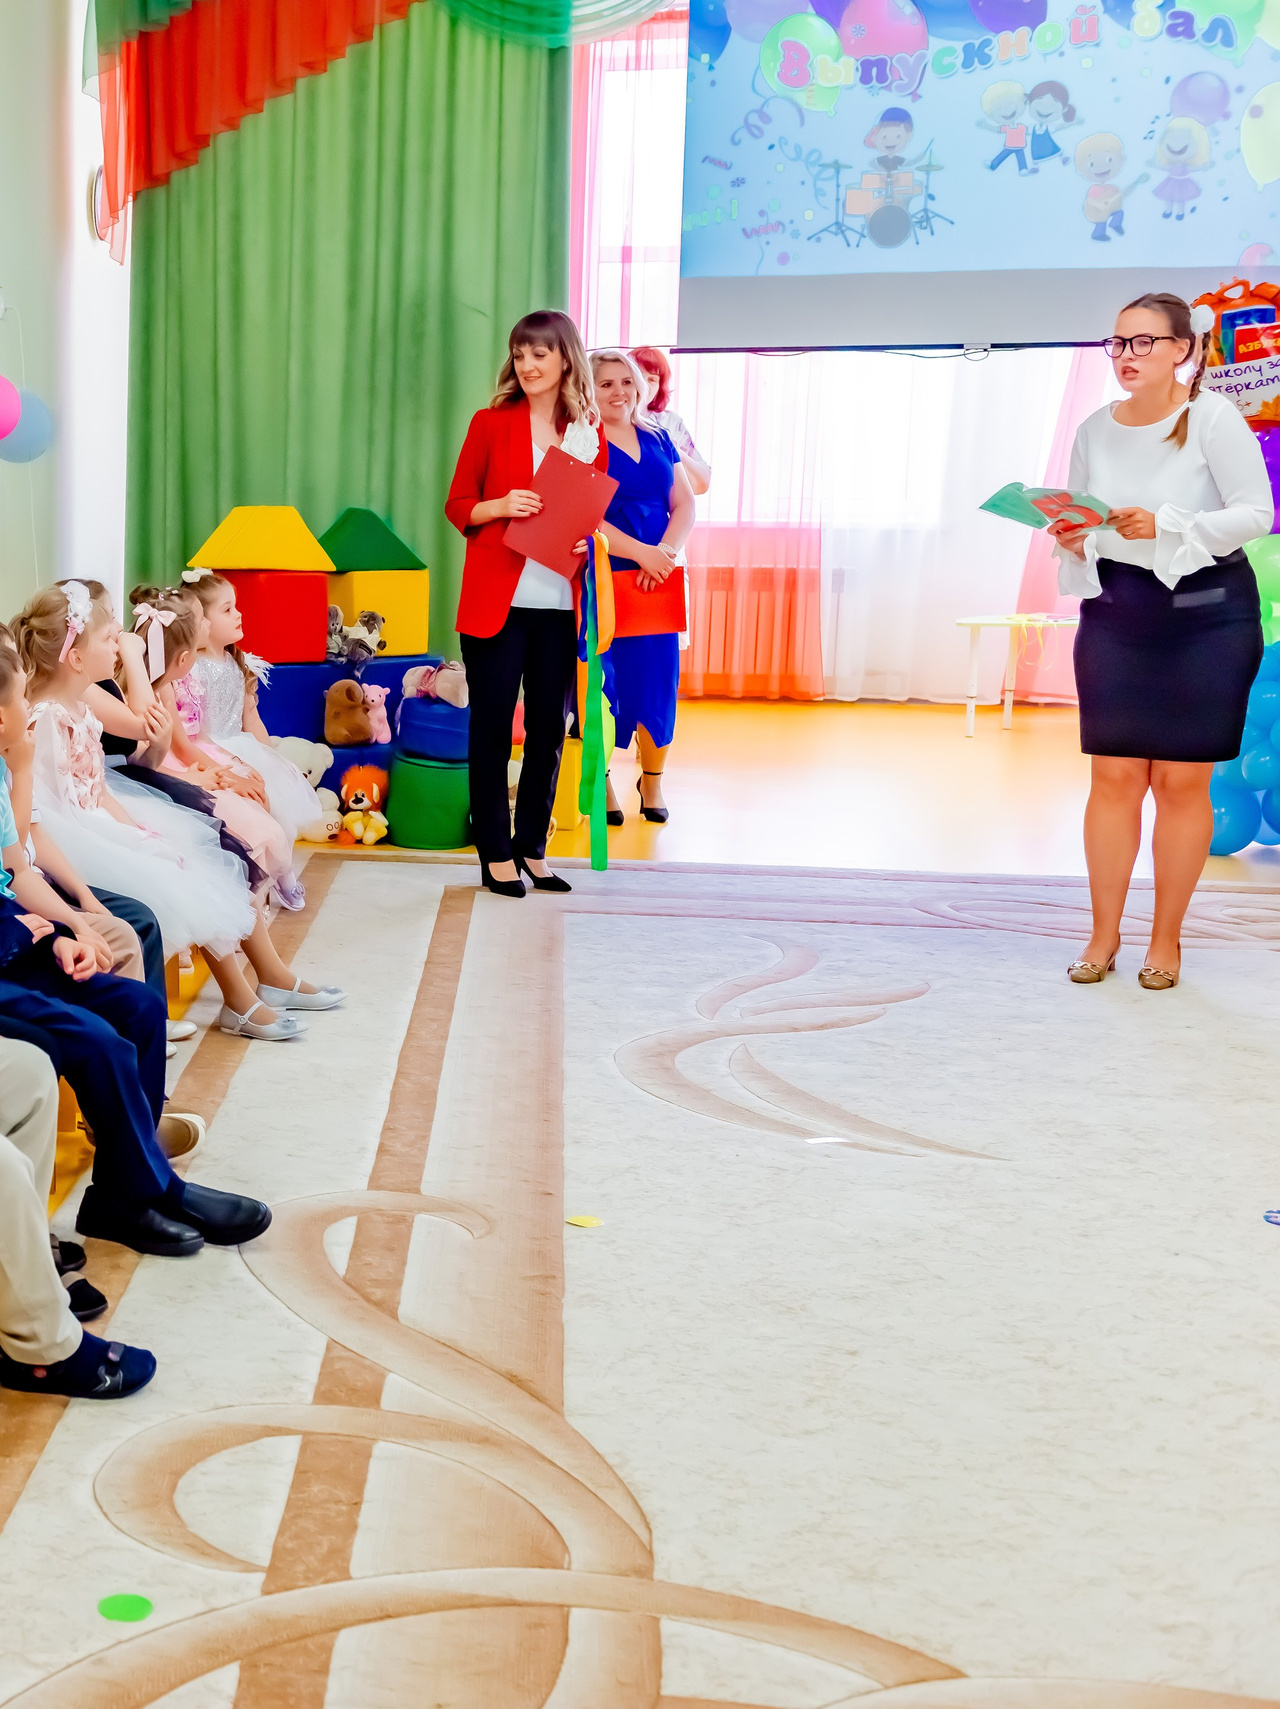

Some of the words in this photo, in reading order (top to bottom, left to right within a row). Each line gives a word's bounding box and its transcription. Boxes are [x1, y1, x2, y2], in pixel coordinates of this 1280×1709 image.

[777, 5, 1099, 96] Выпускной
[1132, 0, 1236, 49] бал
[1211, 365, 1263, 378] школу
